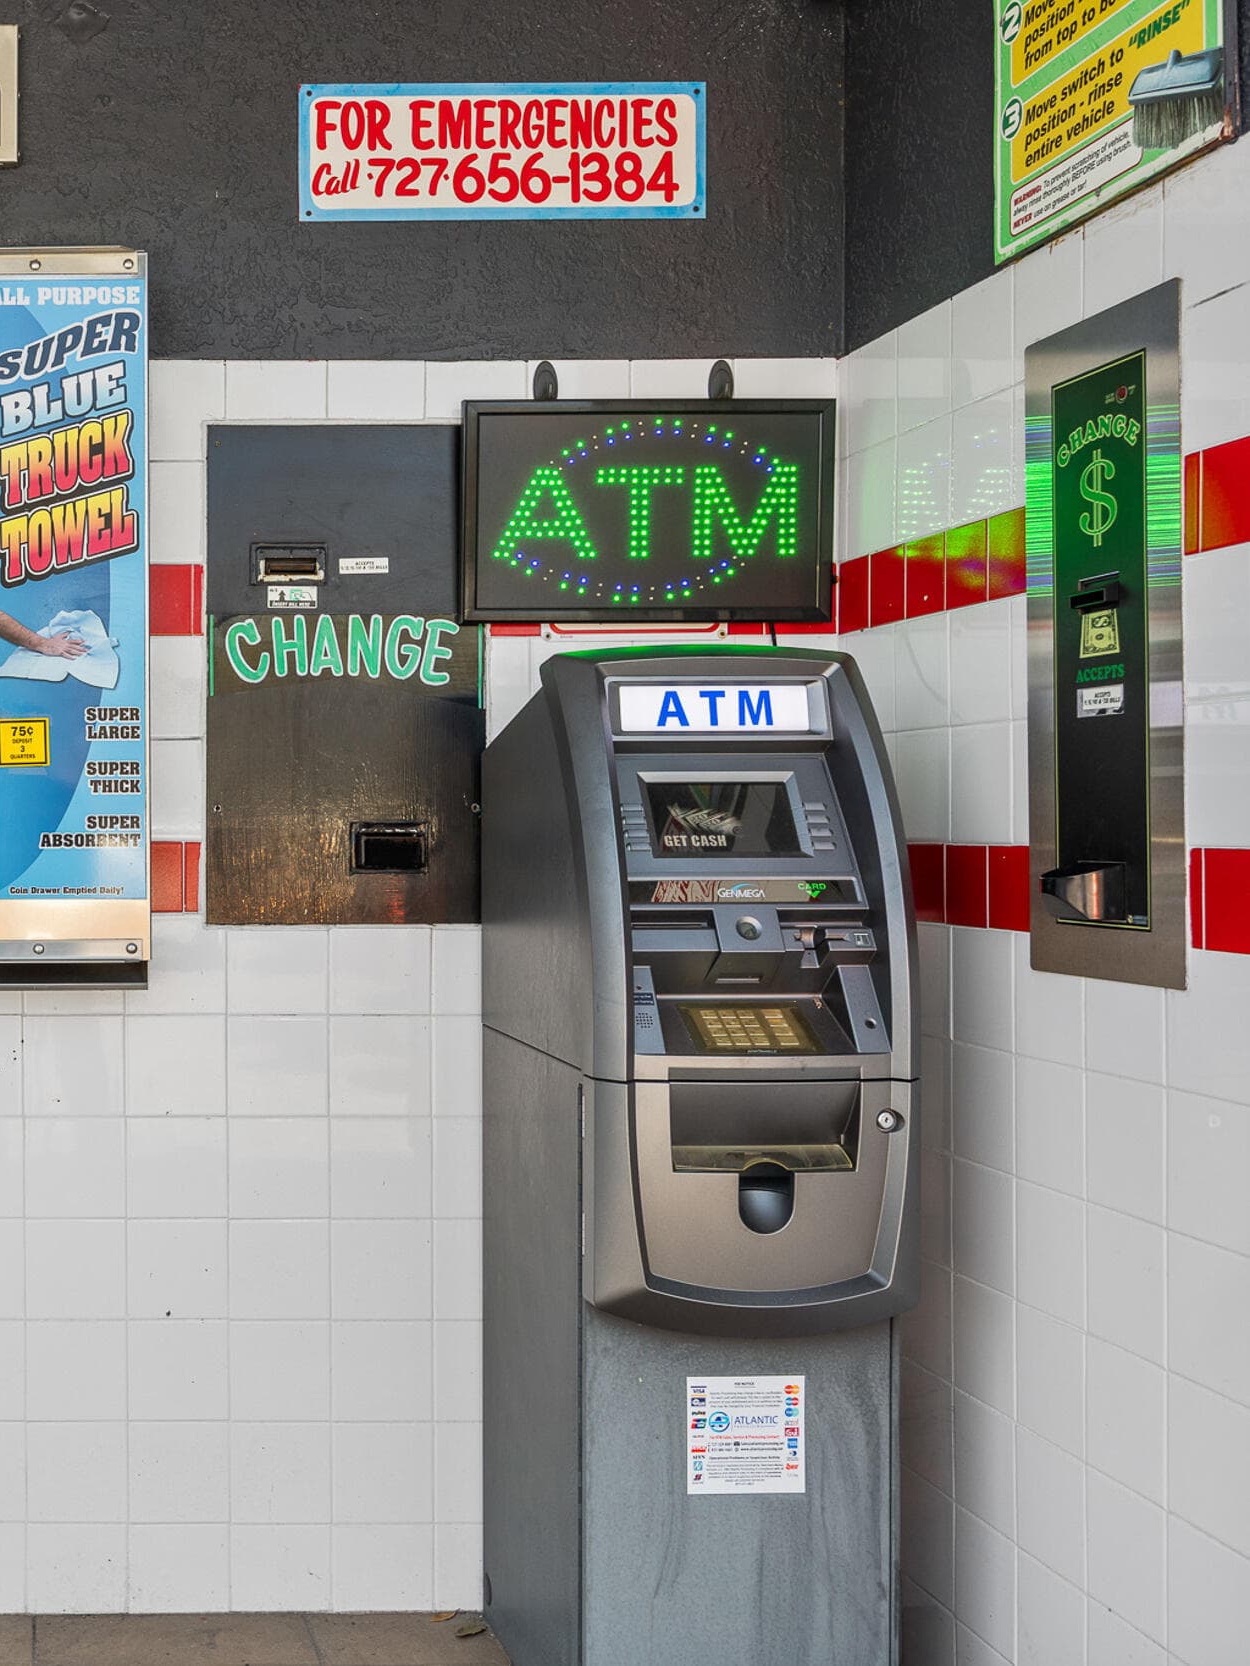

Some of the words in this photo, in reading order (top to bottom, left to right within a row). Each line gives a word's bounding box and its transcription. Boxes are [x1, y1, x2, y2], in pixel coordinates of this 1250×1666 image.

[1003, 5, 1020, 40] 2
[1024, 1, 1074, 54] position
[1024, 39, 1052, 70] from
[1057, 20, 1078, 45] top
[1082, 8, 1095, 26] to
[1025, 94, 1056, 126] Move
[1060, 58, 1105, 100] switch
[1110, 48, 1124, 68] to
[314, 100, 392, 150] FOR
[409, 98, 678, 150] EMERGENCIES
[1004, 103, 1020, 137] 3
[1025, 103, 1076, 152] position
[1088, 72, 1122, 106] rinse
[1026, 135, 1062, 168] entire
[1066, 100, 1114, 141] vehicle
[312, 158, 360, 196] Call
[1042, 180, 1070, 200] thoroughly
[1072, 161, 1095, 182] BEFORE
[1096, 152, 1112, 166] using
[1050, 166, 1070, 185] prevent
[1072, 149, 1100, 170] scratching
[1100, 143, 1107, 154] of
[1034, 207, 1042, 218] use
[1052, 194, 1070, 210] grease
[38, 286, 140, 306] PURPOSE
[0, 360, 126, 437] BLUE
[1057, 414, 1140, 468] CHANGE
[494, 466, 797, 558] ATM
[0, 487, 136, 583] TOWEL
[226, 614, 460, 685] CHANGE
[1076, 664, 1125, 683] ACCEPTS
[86, 707, 140, 722] SUPER
[656, 690, 774, 726] ATM
[11, 726, 34, 737] 75¢
[87, 726, 141, 740] LARGE
[86, 762, 140, 776] SUPER
[90, 780, 141, 794] THICK
[86, 816, 140, 830] SUPER
[40, 834, 141, 848] ABSORBENT
[664, 835, 687, 847] GET
[691, 835, 727, 847] CASH
[10, 886, 29, 894] Coin
[30, 886, 61, 895] Drawer
[63, 886, 97, 896] Emptied
[100, 886, 124, 896] Daily!
[717, 888, 766, 898] GENMEGA
[734, 1416, 778, 1424] ATLANTIC
